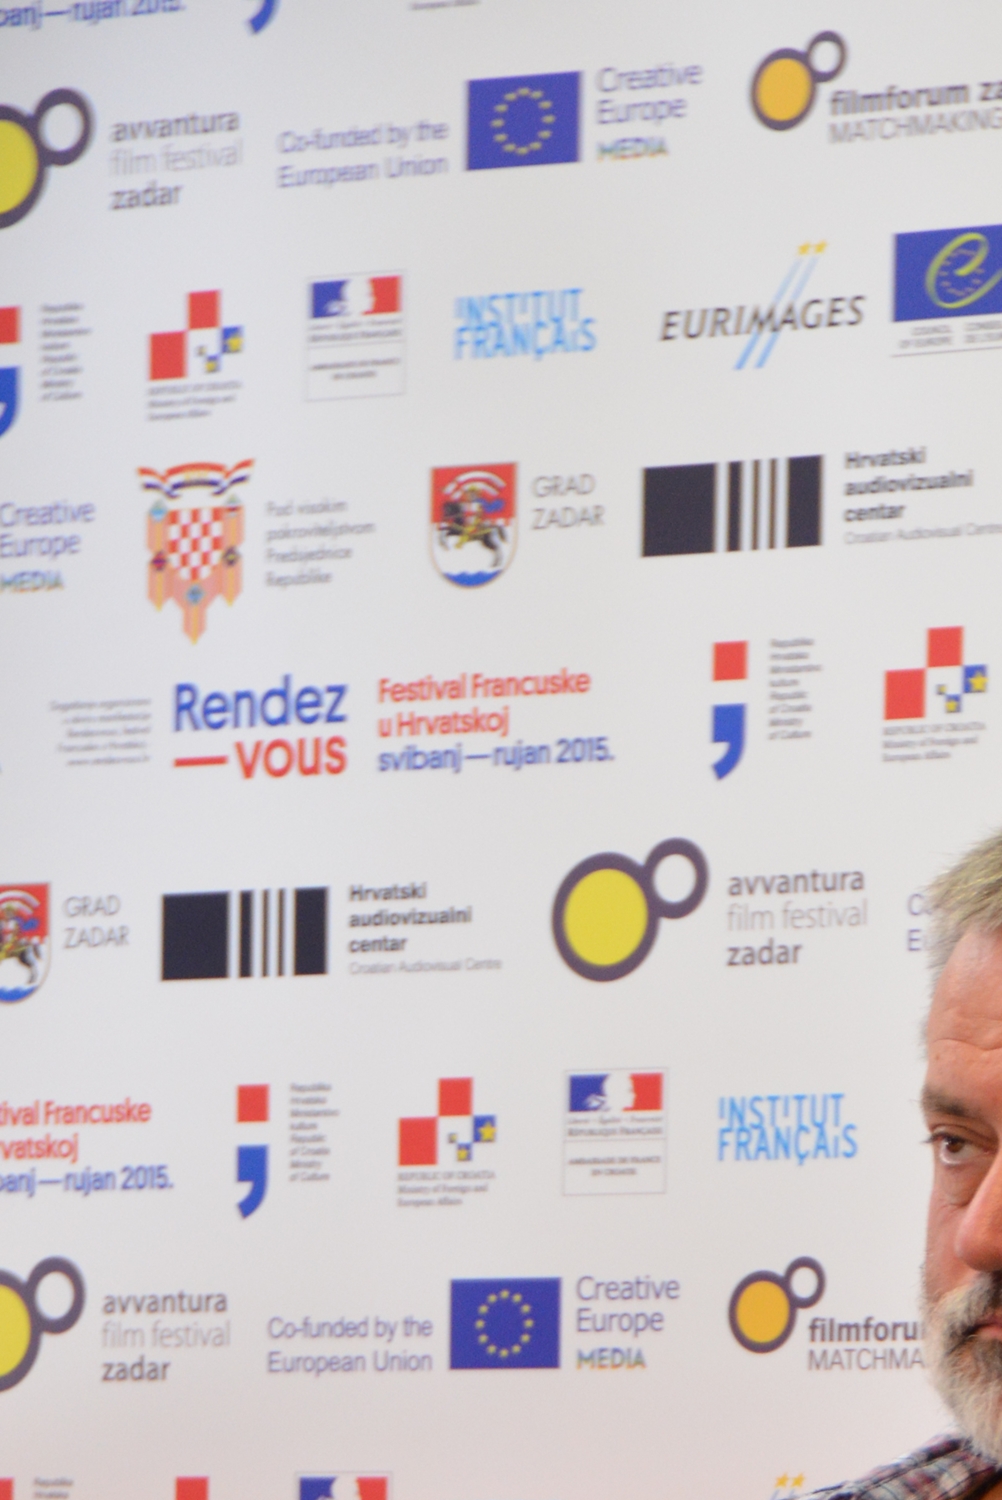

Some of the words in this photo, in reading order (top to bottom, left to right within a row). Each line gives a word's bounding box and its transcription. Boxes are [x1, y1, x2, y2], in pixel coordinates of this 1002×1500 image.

[596, 63, 704, 94] Creative
[597, 98, 687, 126] Europe
[829, 84, 970, 116] filmforum
[110, 111, 241, 143] avvantura
[278, 125, 380, 155] Co-funded
[385, 124, 412, 149] by
[416, 120, 449, 143] the
[110, 147, 157, 177] film
[162, 139, 243, 172] festival
[597, 137, 668, 161] MEDIA
[278, 162, 380, 190] European
[386, 155, 449, 180] Union
[110, 183, 184, 211] zadar
[454, 288, 583, 322] INSTITUT
[659, 295, 867, 342] EURIMAGES
[844, 446, 926, 470] Hrvatski
[532, 472, 596, 499] GRAD
[844, 470, 974, 497] audiovizualni
[0, 499, 96, 527] Creative
[531, 504, 604, 531] ZADAR
[844, 502, 905, 524] centar
[0, 532, 82, 560] Europe
[378, 673, 467, 703] Festival
[471, 667, 592, 699] Francuske
[172, 674, 348, 732] Rendez
[378, 717, 392, 738] u
[397, 705, 510, 738] Hrvatskoj
[556, 735, 615, 764] 2015.
[349, 882, 428, 903] Hrvatski
[728, 868, 865, 897] avvantura
[64, 896, 121, 918] GRAD
[349, 906, 472, 929] audiovizualni
[727, 903, 774, 932] film
[782, 898, 868, 929] festival
[64, 925, 130, 950] ZADAR
[349, 935, 407, 954] centar
[727, 940, 804, 968] zadar
[44, 1096, 153, 1126] Francuske
[718, 1093, 845, 1129] INSTITUT
[120, 1164, 174, 1190] 2015.
[576, 1274, 680, 1302] Creative
[102, 1289, 228, 1316] avvantura
[101, 1321, 146, 1349] film
[151, 1319, 231, 1347] festival
[267, 1315, 369, 1341] Co-funded
[373, 1316, 399, 1343] by
[402, 1315, 433, 1338] the
[576, 1308, 665, 1339] Europe
[808, 1316, 924, 1342] filmforu
[101, 1354, 170, 1382] zadar
[267, 1352, 366, 1379] European
[372, 1350, 433, 1374] Union
[576, 1346, 647, 1371] MEDIA
[808, 1347, 925, 1370] MATCHMA
